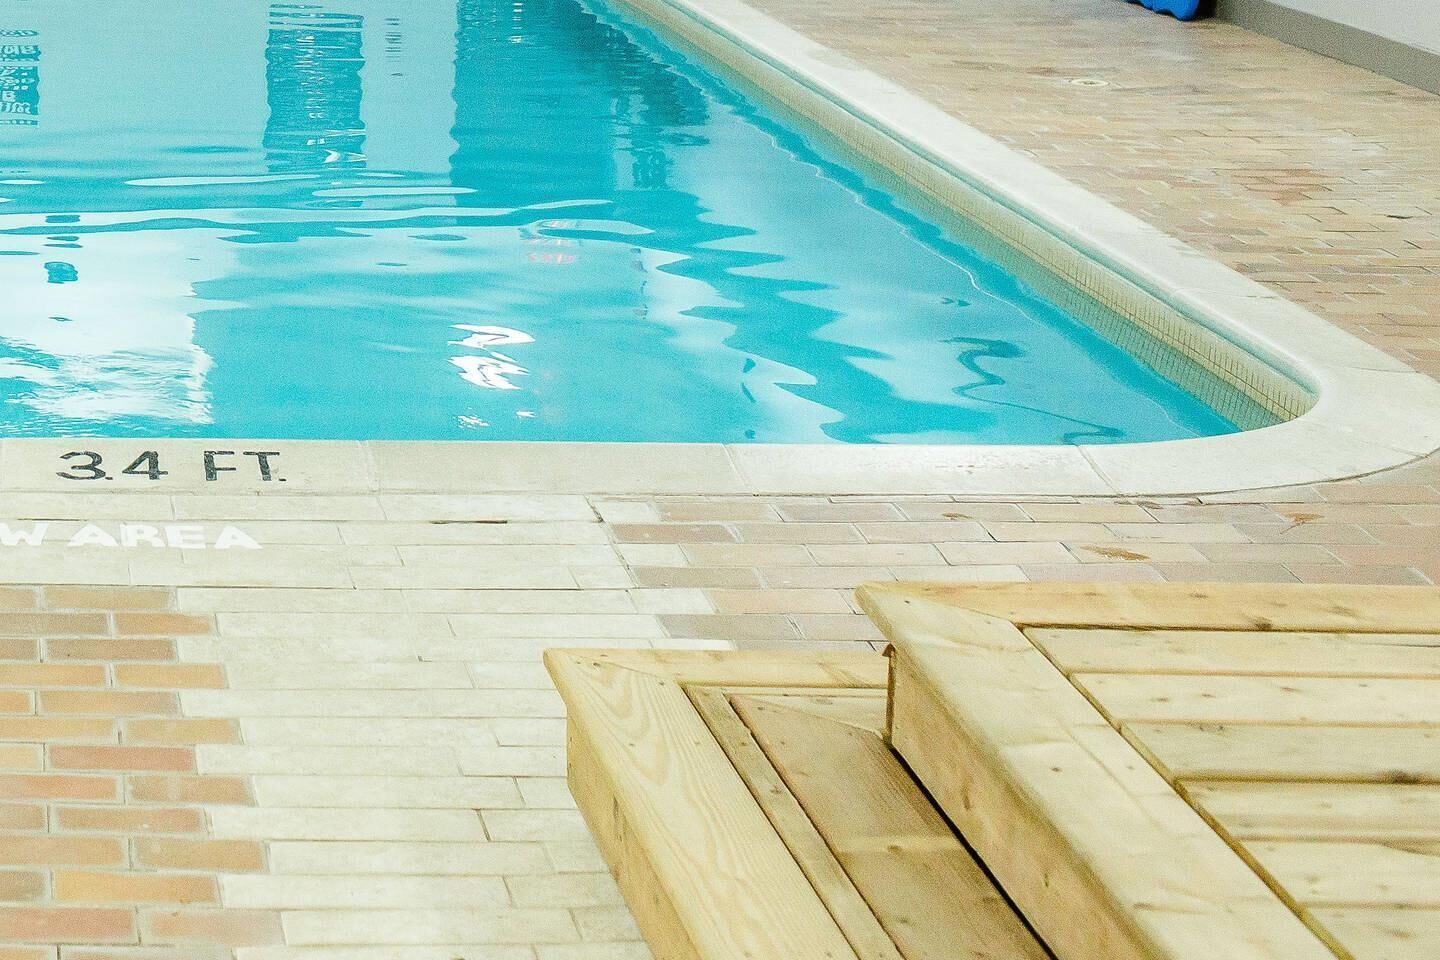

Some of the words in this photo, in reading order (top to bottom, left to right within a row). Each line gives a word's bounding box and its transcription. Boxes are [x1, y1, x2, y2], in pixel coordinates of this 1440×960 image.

[56, 450, 168, 481] 3.4
[203, 450, 287, 482] FT.
[67, 523, 263, 549] AREA
